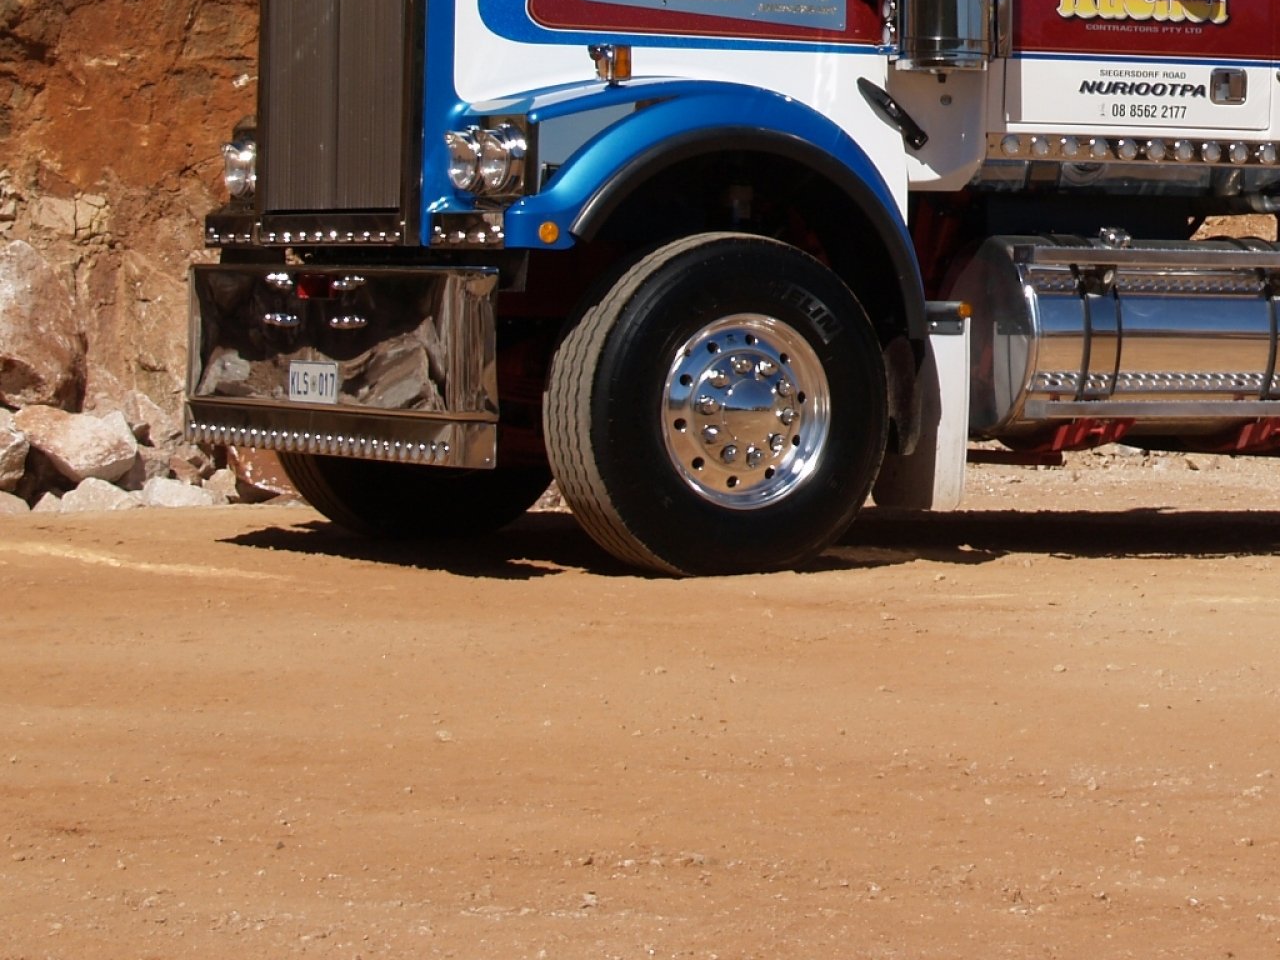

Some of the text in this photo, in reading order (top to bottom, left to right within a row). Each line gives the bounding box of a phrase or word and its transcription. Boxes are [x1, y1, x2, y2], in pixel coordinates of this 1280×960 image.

[1085, 24, 1159, 33] CONTRACTORS
[1162, 26, 1182, 34] PTY
[1099, 69, 1187, 80] SIEGERSDORF ROAD
[1079, 80, 1207, 98] NURIOOTPA
[1111, 103, 1187, 119] 08 8562 2177
